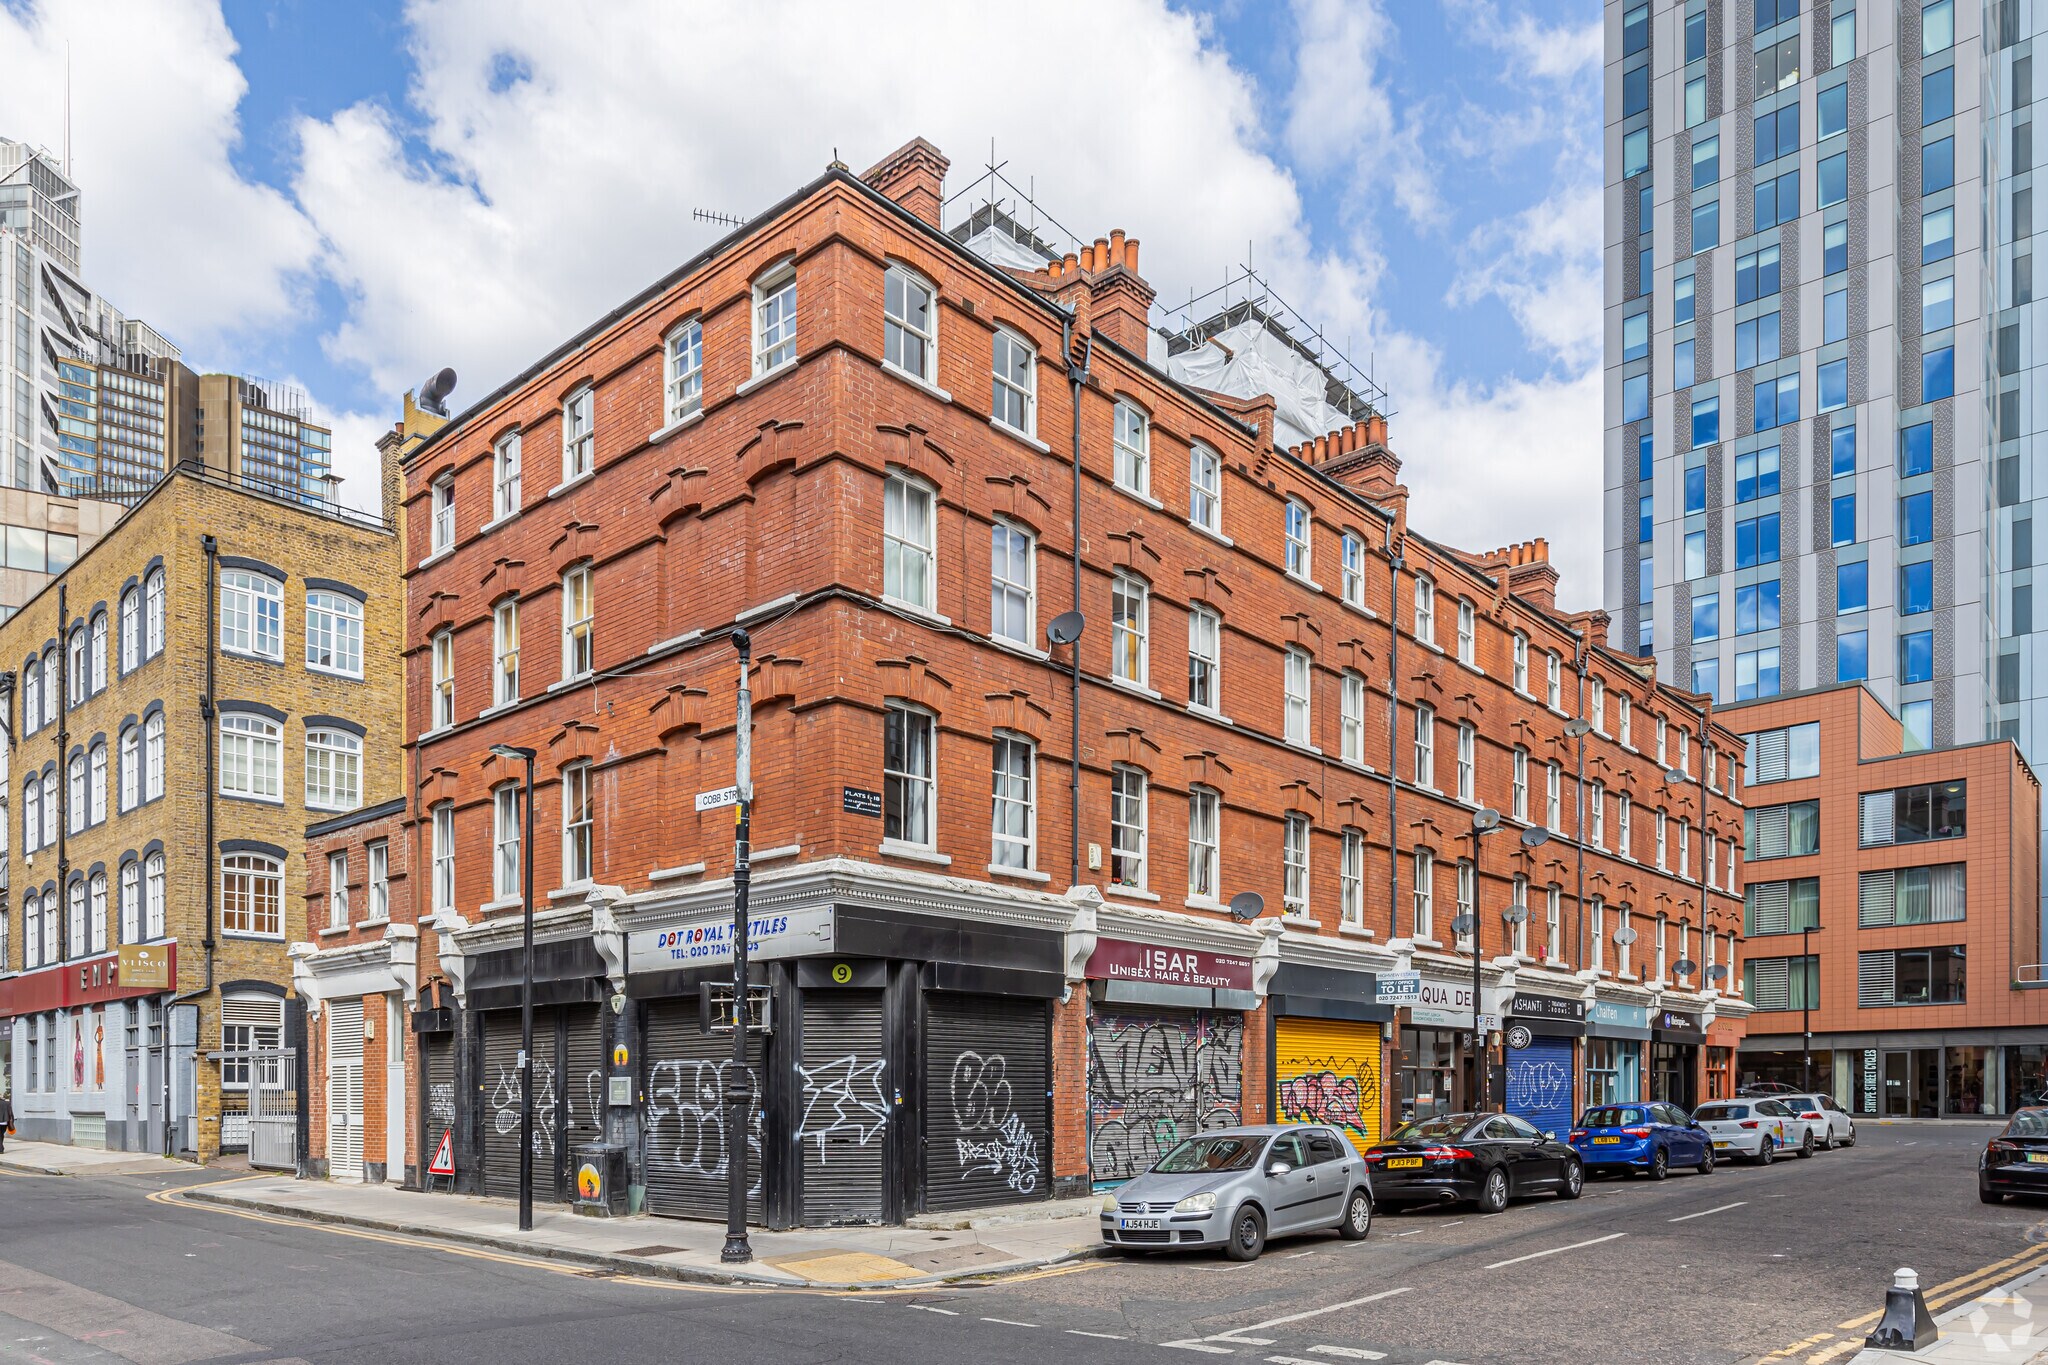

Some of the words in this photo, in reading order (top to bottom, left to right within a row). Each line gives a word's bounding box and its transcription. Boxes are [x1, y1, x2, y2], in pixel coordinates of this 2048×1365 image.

[702, 793, 722, 805] COBB
[723, 790, 738, 801] STR
[845, 790, 866, 799] FLATS
[658, 931, 684, 948] DOT
[685, 925, 724, 945] ROYAL
[671, 949, 688, 960] TEL:
[690, 945, 709, 957] 020
[711, 942, 731, 956] 7247
[1146, 949, 1198, 974] ISAR
[837, 966, 848, 981] 9
[1154, 970, 1180, 982] HAIR
[1183, 973, 1191, 983] &
[1193, 974, 1231, 987] BEAUTY
[1381, 985, 1395, 994] TO
[1397, 984, 1415, 993] LET
[1420, 986, 1448, 1005] QUA
[1864, 1049, 1877, 1070] CYCLES
[1864, 1070, 1877, 1091] STREET
[1864, 1091, 1877, 1113] STRYPE
[1125, 1220, 1143, 1229] AJ54
[1143, 1220, 1159, 1229] HJE
